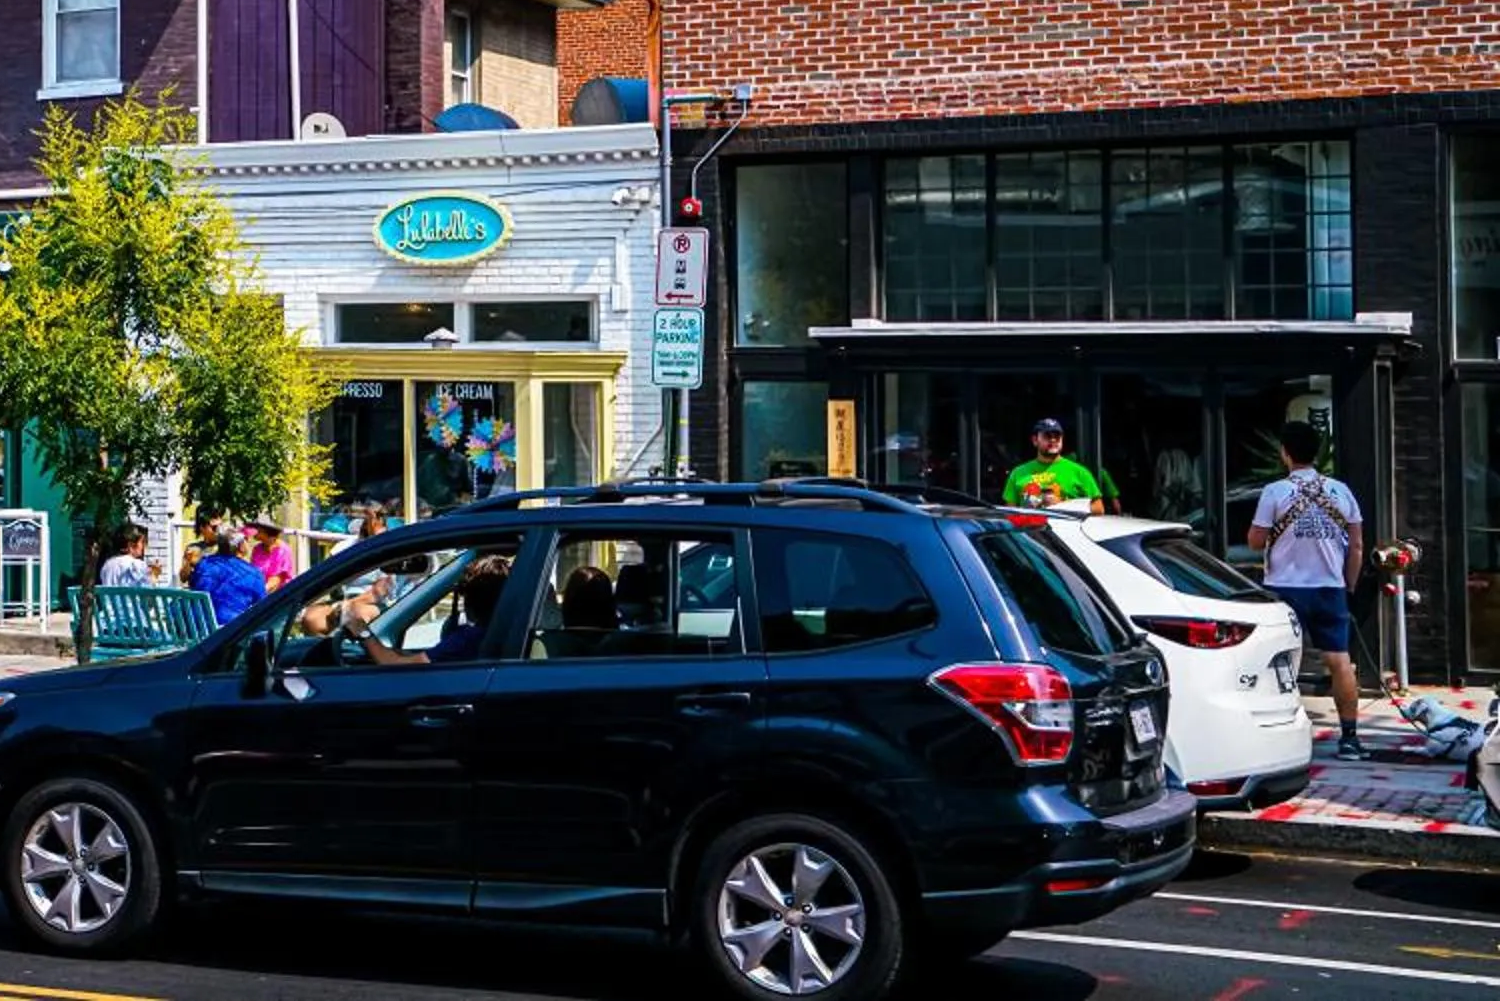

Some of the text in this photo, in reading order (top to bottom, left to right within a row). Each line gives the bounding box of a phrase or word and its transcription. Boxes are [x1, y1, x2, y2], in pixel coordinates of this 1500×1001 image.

[660, 318, 697, 329] 2 HOUR
[436, 382, 493, 399] ICE CREAM
